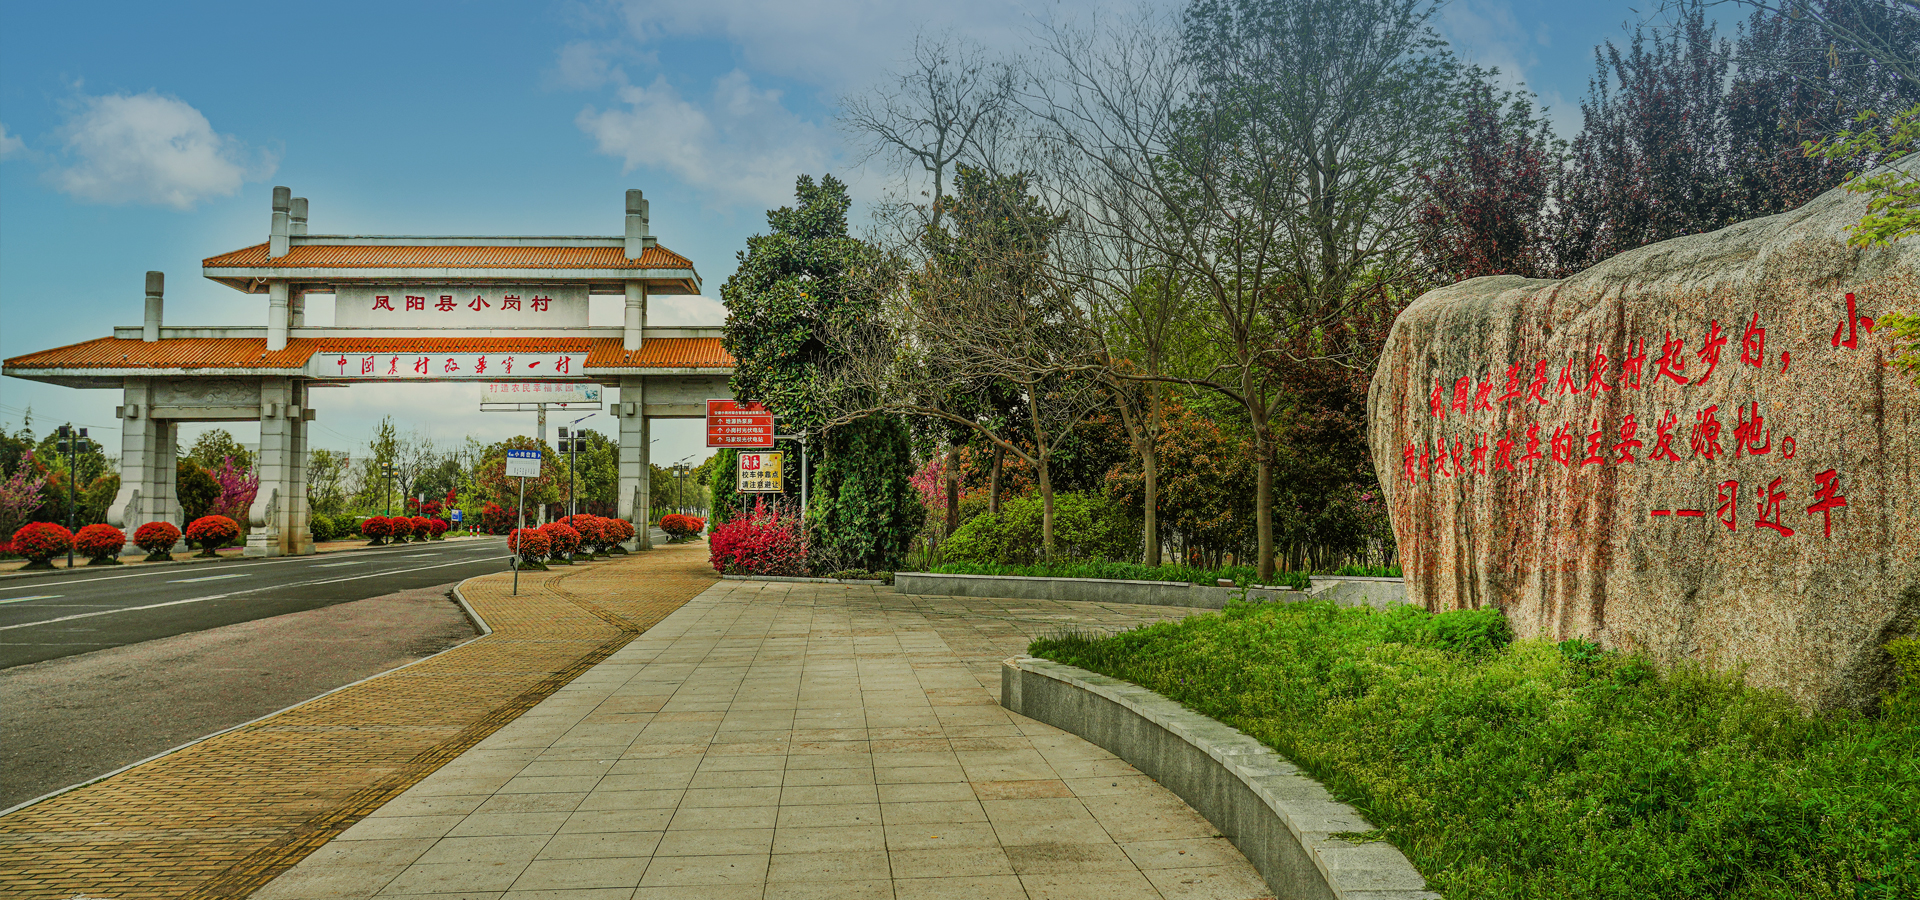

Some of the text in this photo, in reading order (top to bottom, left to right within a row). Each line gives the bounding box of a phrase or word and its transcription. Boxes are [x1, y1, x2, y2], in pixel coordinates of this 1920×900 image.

[372, 295, 552, 312] 凤阳县小岗村
[489, 383, 574, 393] 打造农民幸福家园
[742, 471, 779, 479] 校车停靠点
[742, 481, 779, 489] 请注意避让
